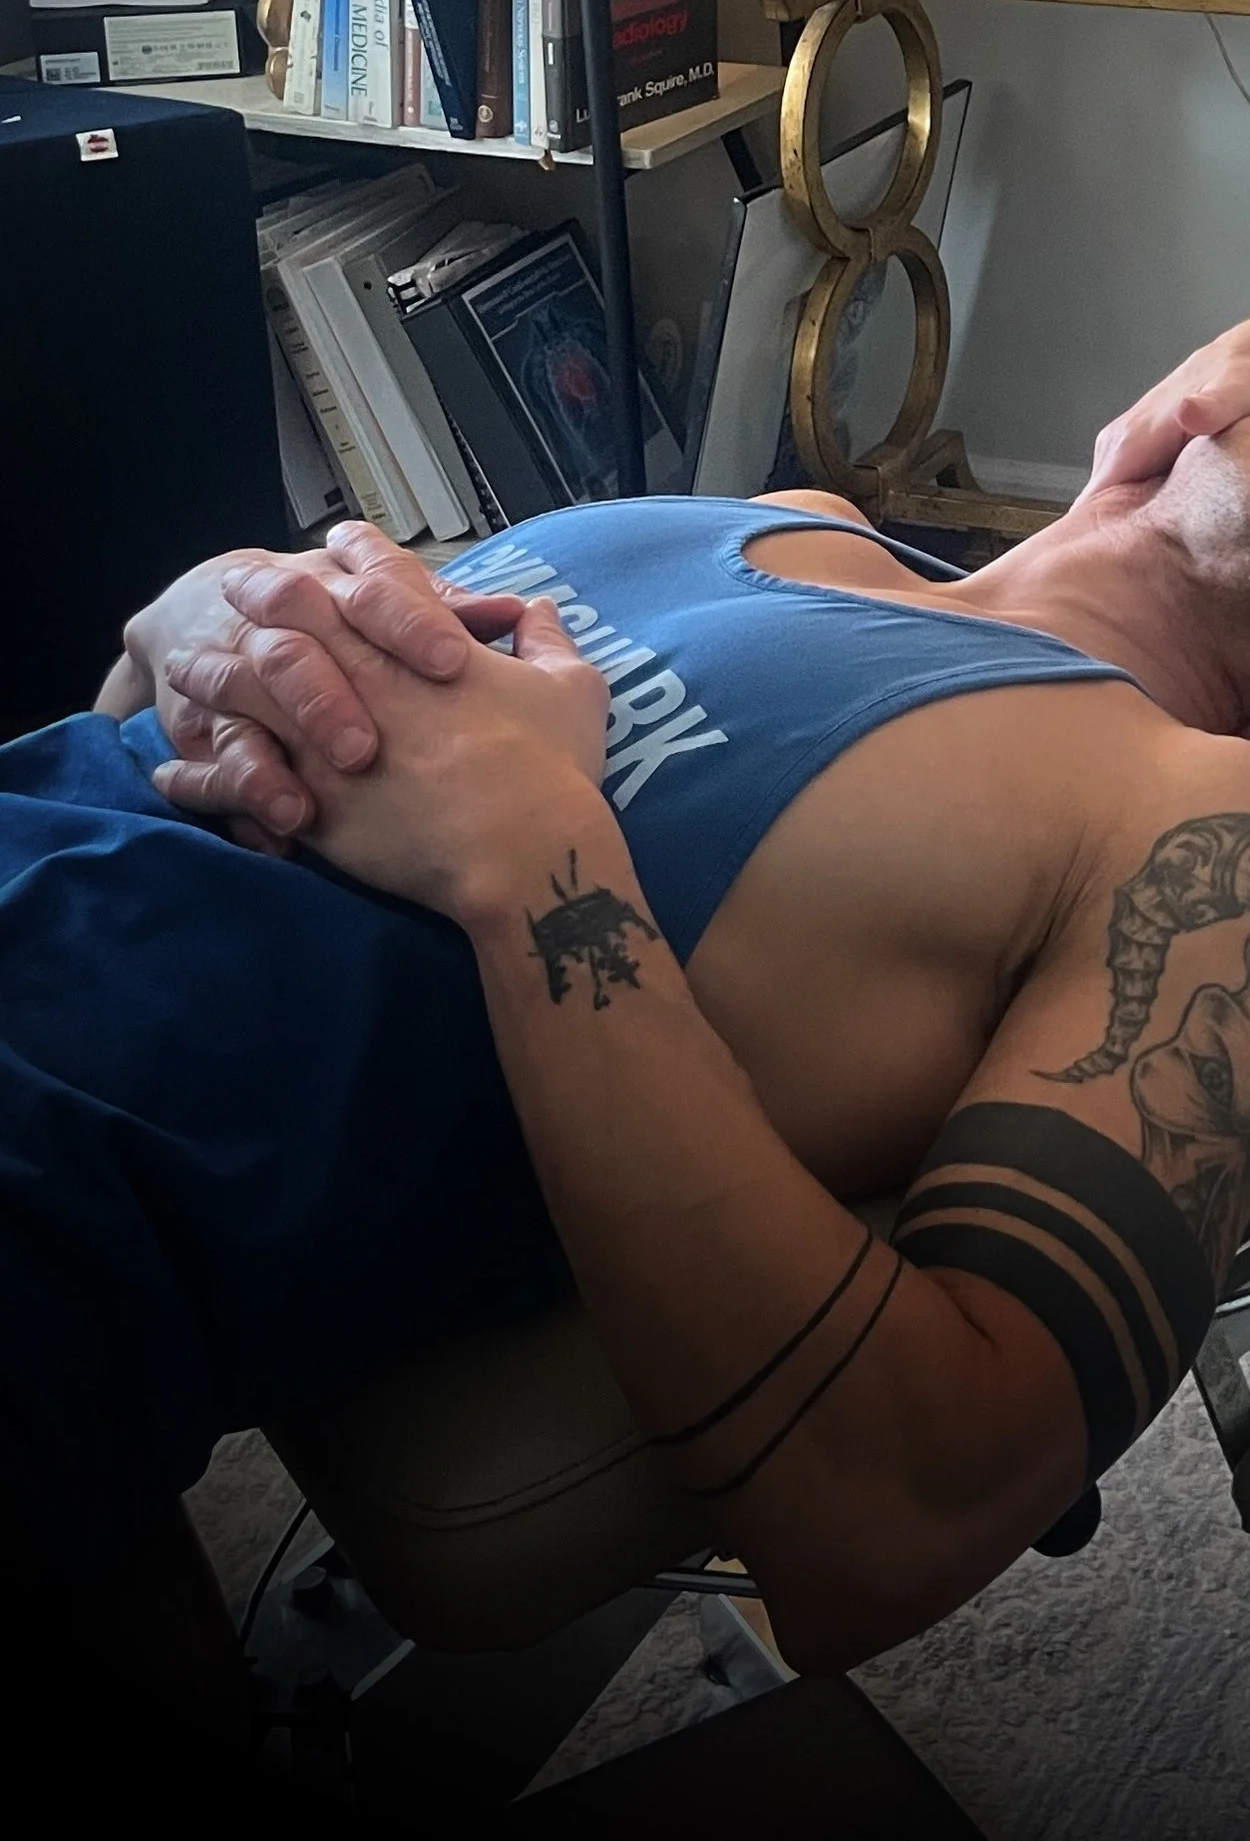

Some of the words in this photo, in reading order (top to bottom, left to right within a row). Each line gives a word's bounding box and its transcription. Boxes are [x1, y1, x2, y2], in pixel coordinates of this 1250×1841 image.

[375, 27, 389, 48] of
[612, 8, 690, 50] adiology
[352, 5, 369, 97] MEDICINE
[644, 71, 688, 98] Squire,
[689, 61, 715, 83] M.D.
